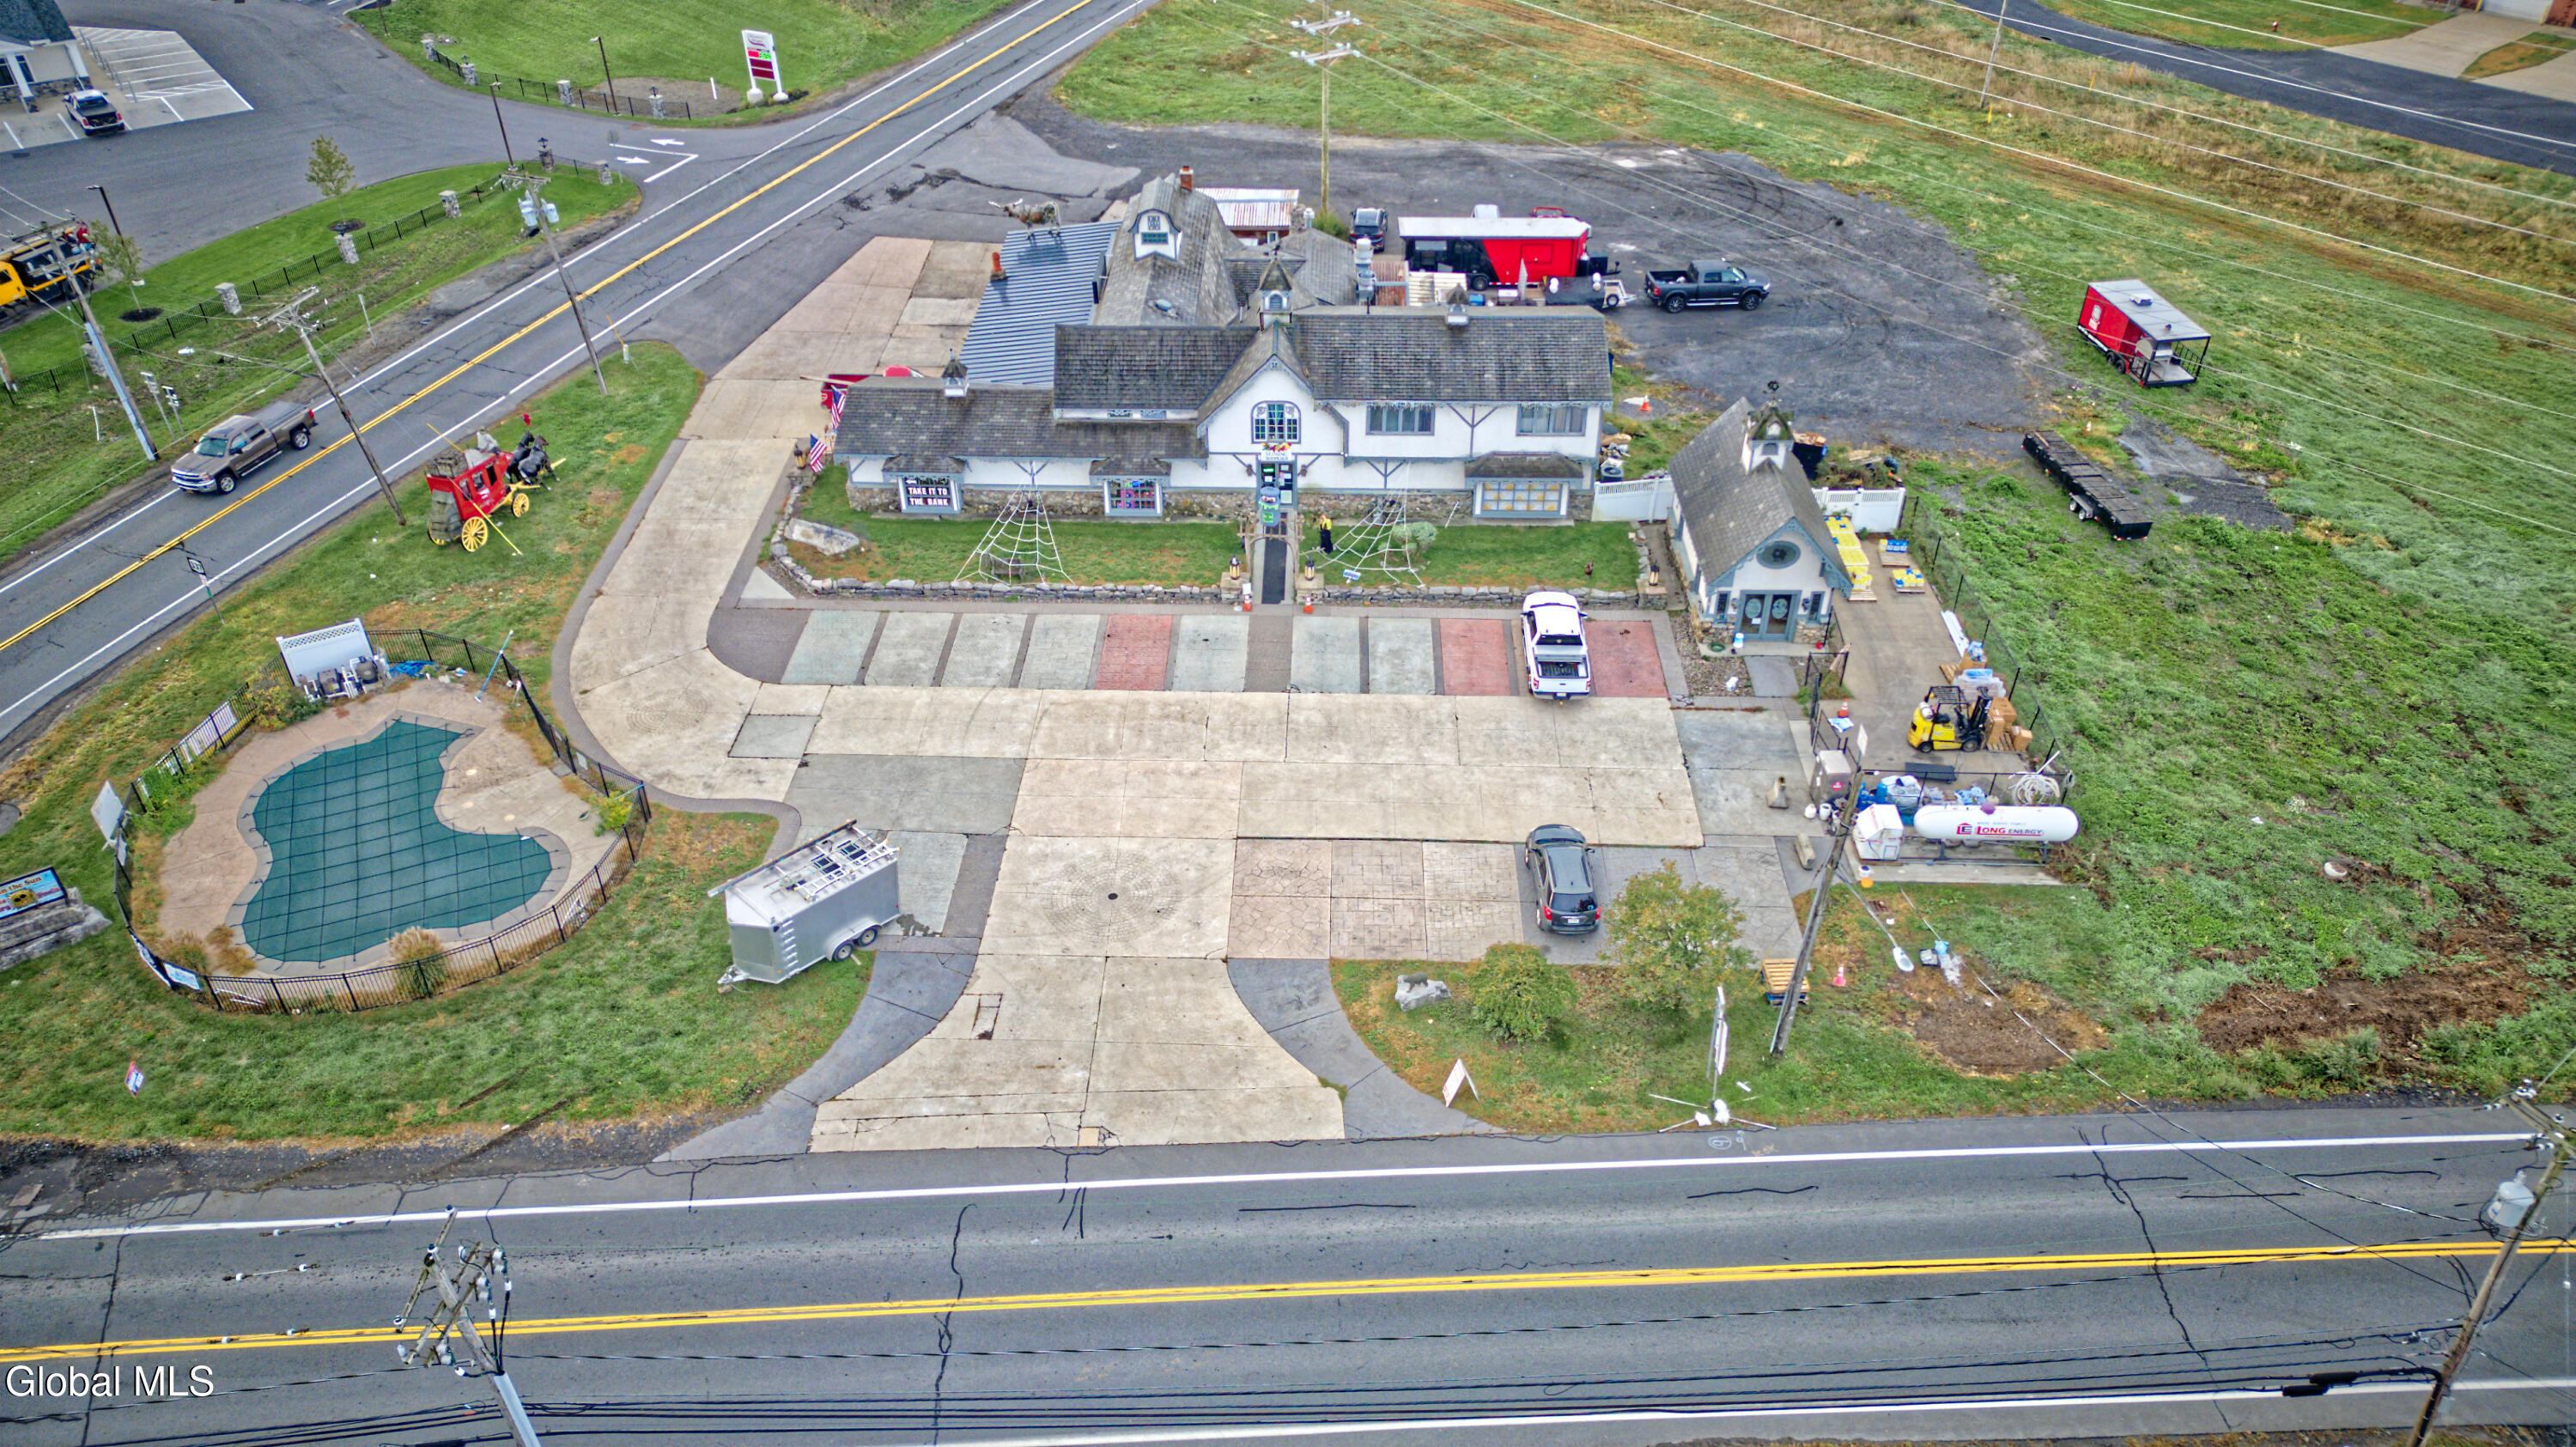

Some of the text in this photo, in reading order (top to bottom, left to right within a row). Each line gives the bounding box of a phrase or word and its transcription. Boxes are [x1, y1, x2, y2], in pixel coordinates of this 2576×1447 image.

[908, 487, 948, 496] TAKE IT TO
[1977, 826, 2006, 835] LONG
